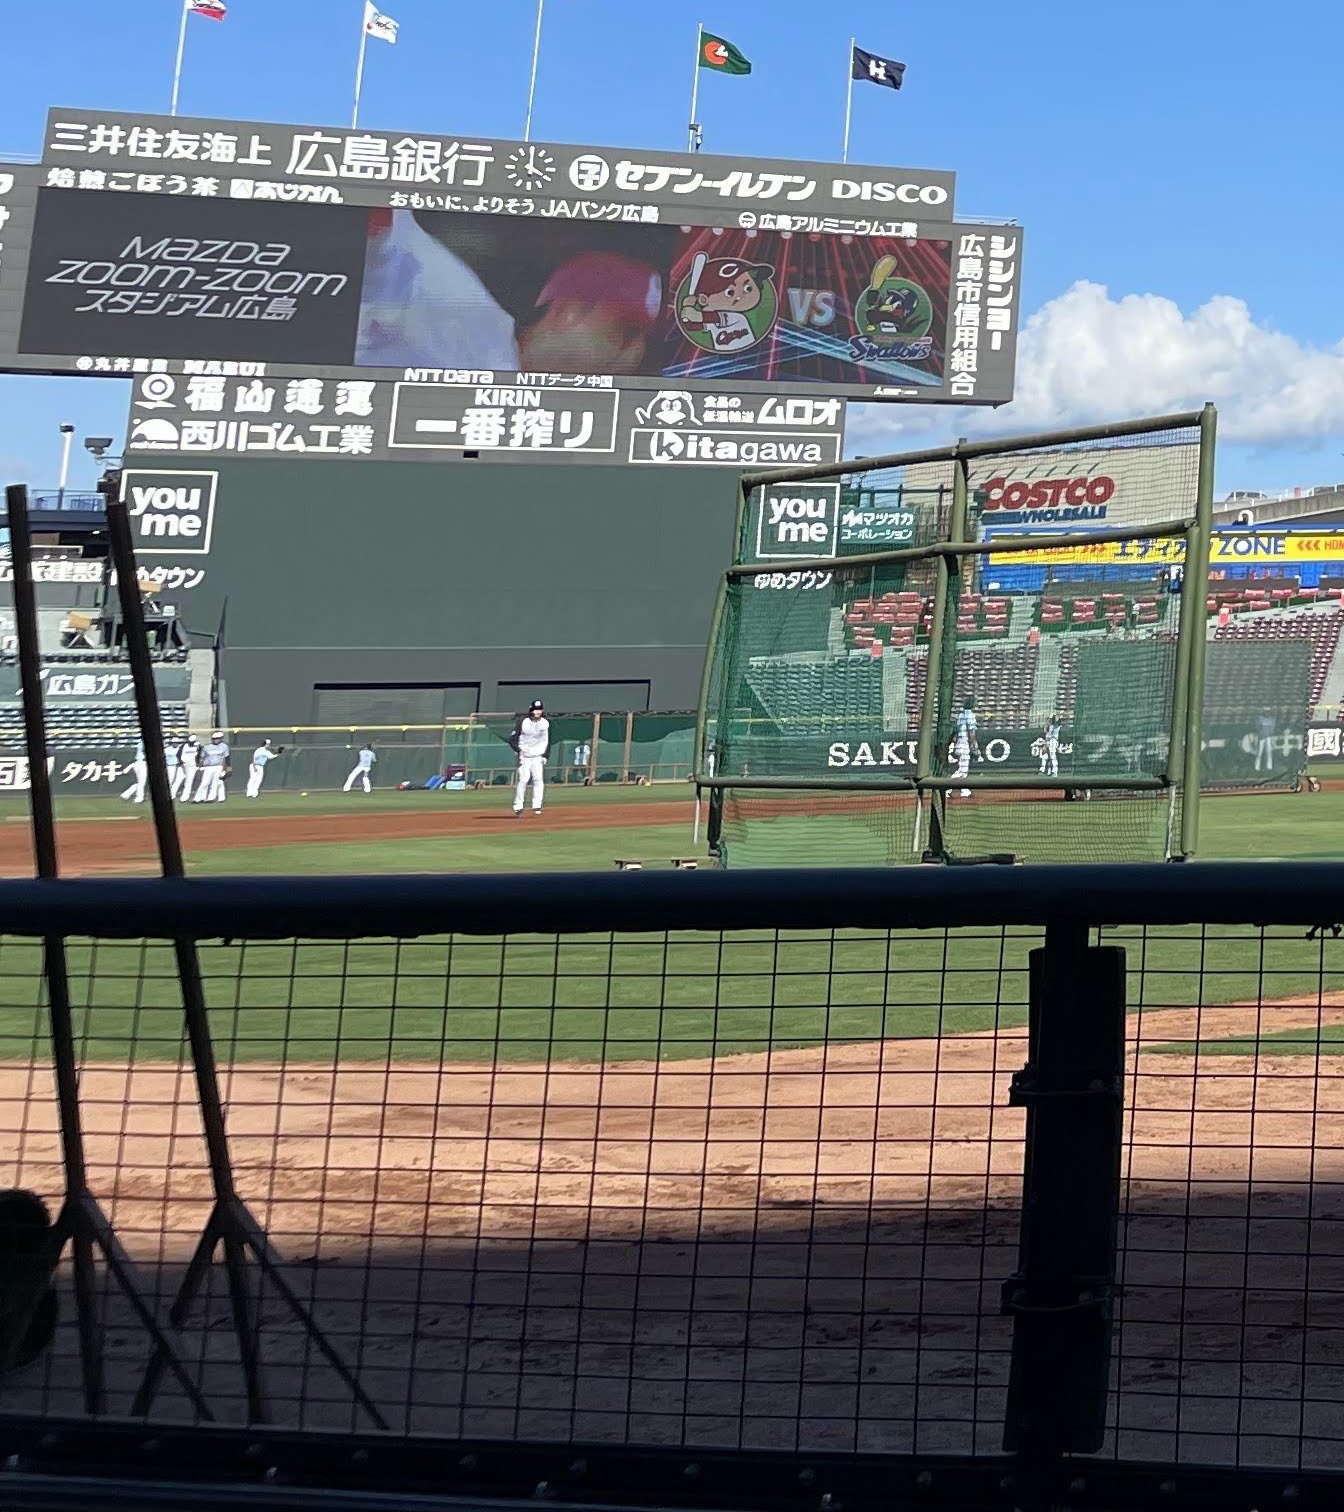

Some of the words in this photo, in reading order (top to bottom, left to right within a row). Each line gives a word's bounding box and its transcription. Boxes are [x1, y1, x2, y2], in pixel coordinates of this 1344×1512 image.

[50, 122, 272, 167] 三井住友海上
[284, 131, 495, 188] 広島銀行
[253, 180, 344, 204] あじかん
[831, 178, 949, 206] DISCO
[388, 191, 536, 215] おもいに、よりそう
[540, 199, 660, 224] JAバンク広島
[758, 213, 919, 238] 広島アルミニウム工業
[74, 288, 299, 322] スタジアム広島
[987, 235, 1017, 350] シシンヨー
[787, 289, 836, 326] VS
[949, 234, 987, 396] 広島市信用組合
[183, 359, 266, 377] MARUI
[516, 372, 613, 388] NTTデータ中国
[184, 376, 376, 417] 福山通運
[474, 389, 541, 407] KIRIN
[757, 398, 842, 426] ムロオ
[180, 420, 375, 455] 西川ゴム工業
[415, 408, 594, 448] 一番搾り
[129, 486, 201, 515] you
[982, 475, 1115, 510] COSTCO
[769, 498, 826, 524] you
[863, 512, 914, 526] マツオカ
[1019, 505, 1107, 523] WHOLESALE
[140, 513, 201, 537] me
[777, 521, 828, 542] me
[840, 529, 913, 540] コーポレーション
[1217, 537, 1285, 555] ZONE
[754, 571, 833, 589] ゆめタウン
[828, 741, 1011, 765] SAKUO
